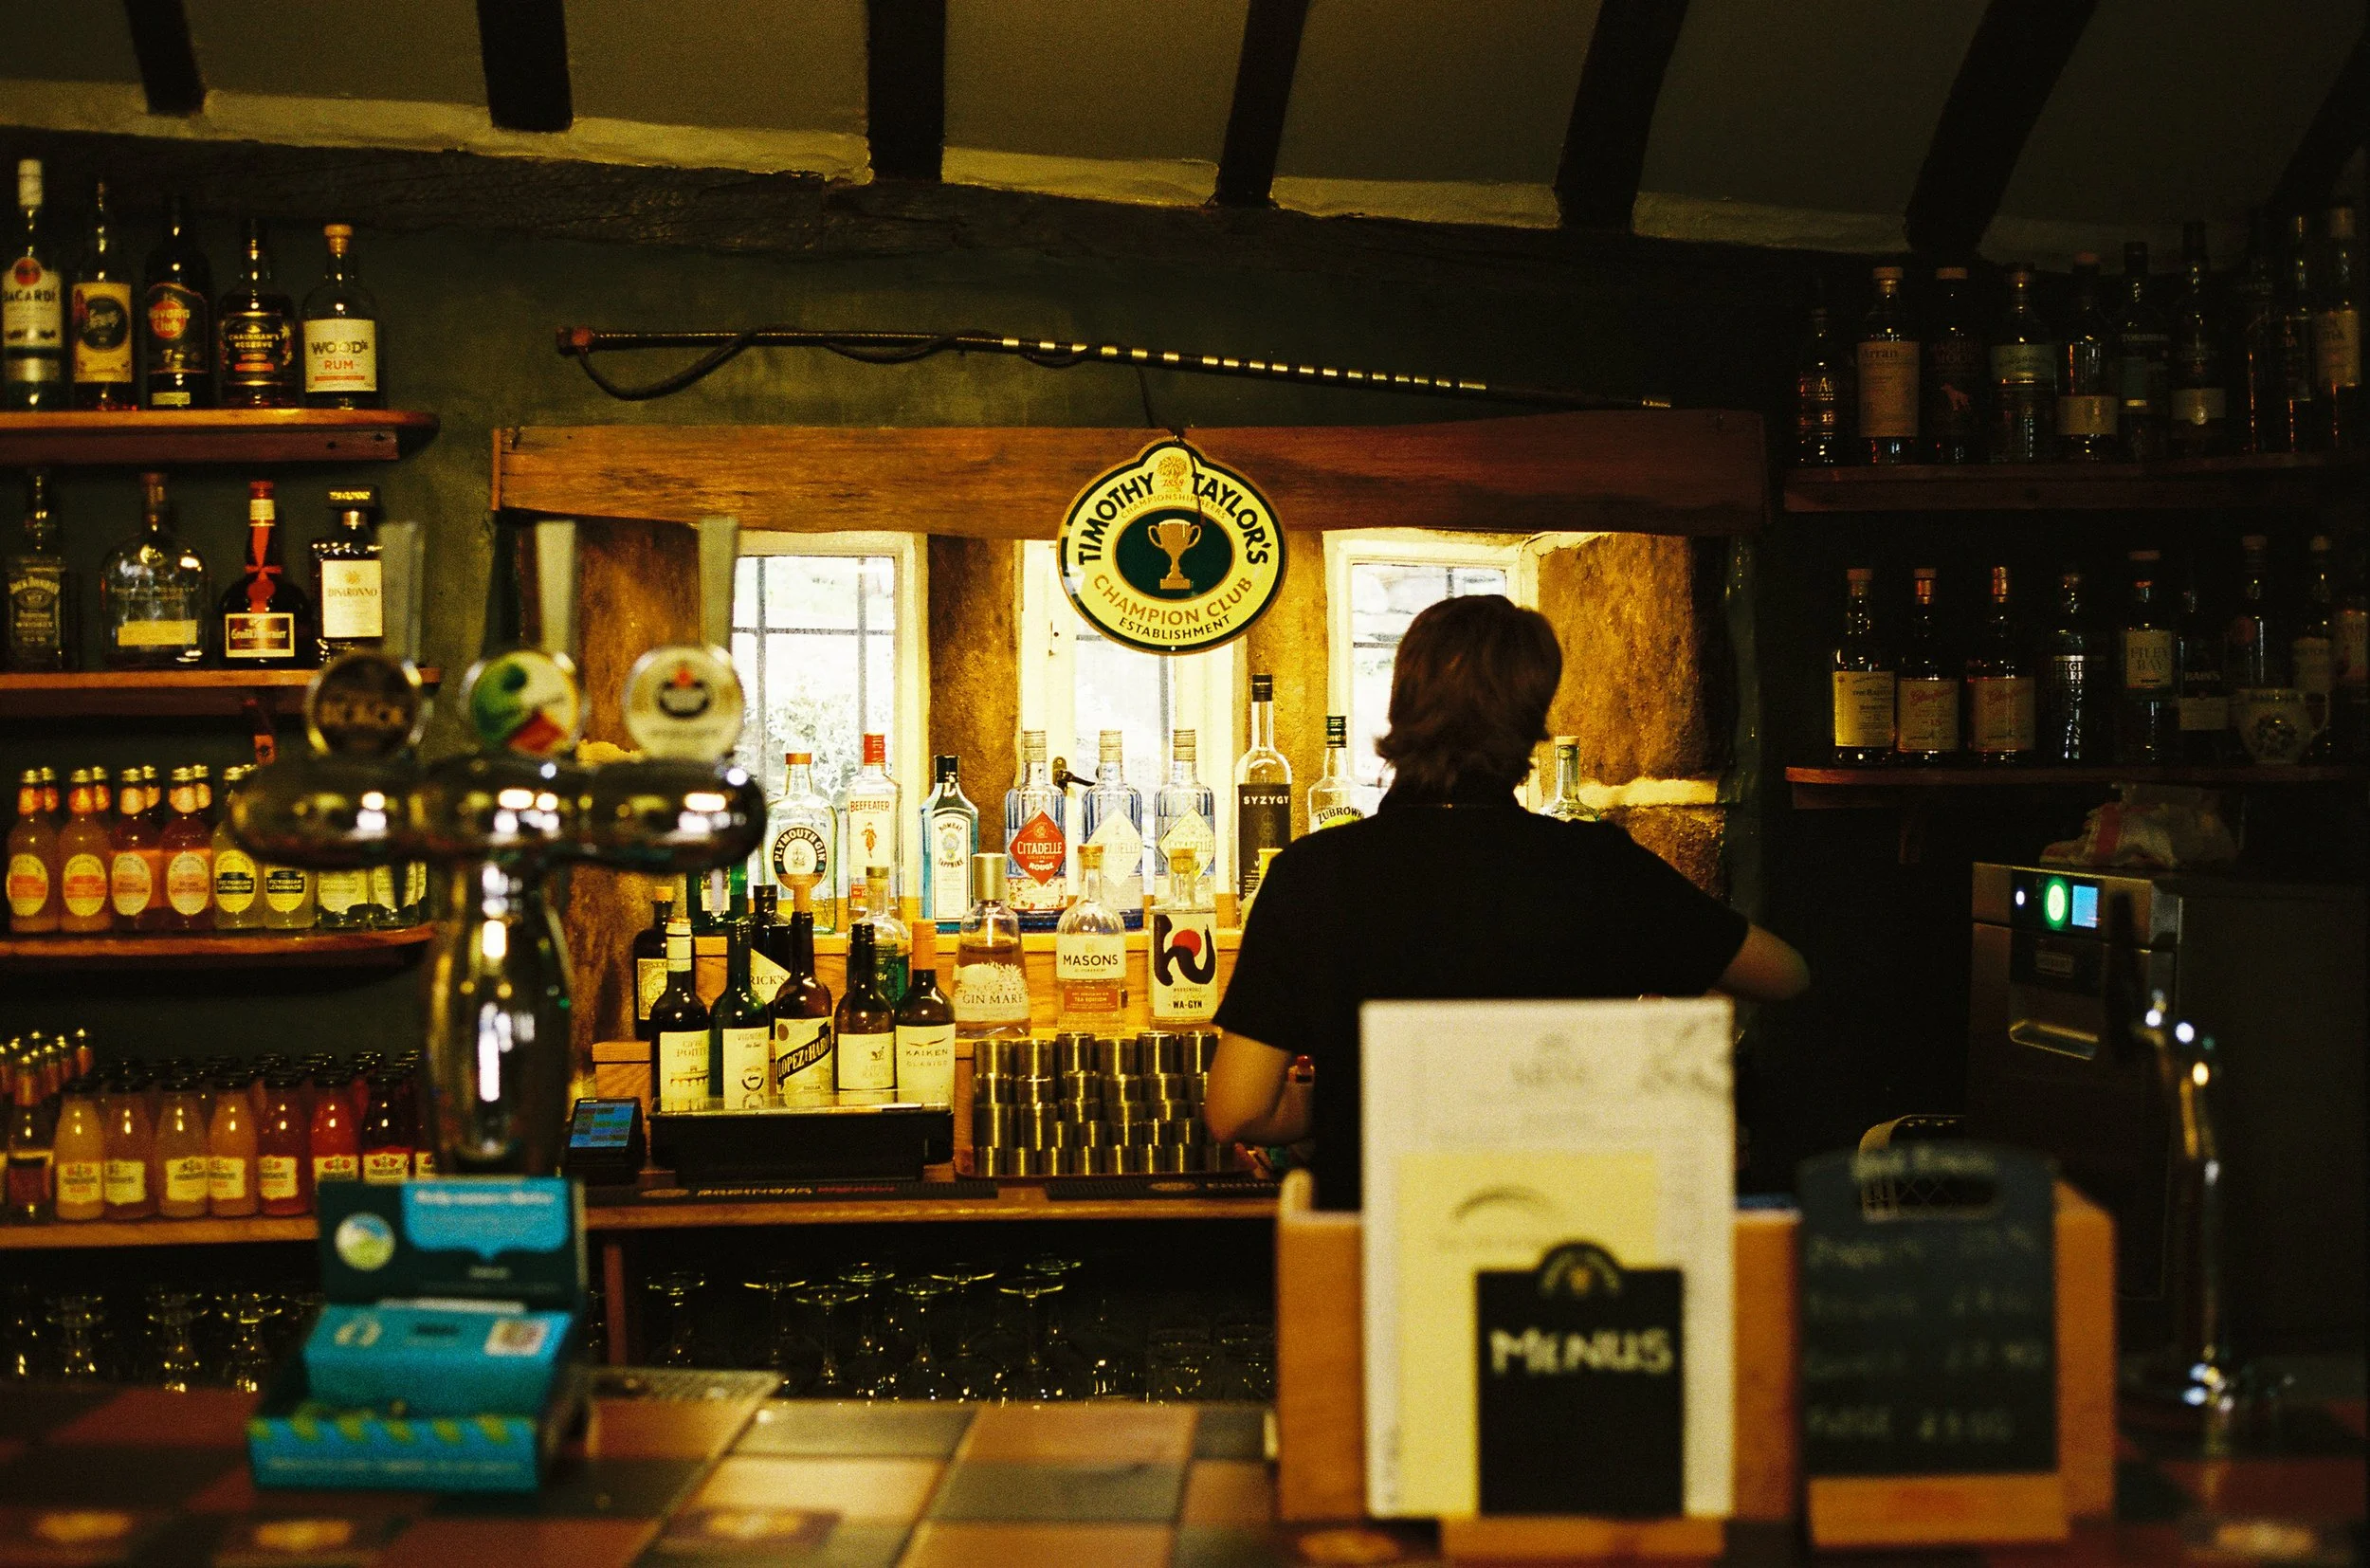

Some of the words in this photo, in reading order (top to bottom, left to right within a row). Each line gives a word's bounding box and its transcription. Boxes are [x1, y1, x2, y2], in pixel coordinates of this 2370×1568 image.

[324, 359, 355, 371] RUM
[1078, 471, 1155, 566] TIMOTHY
[1191, 472, 1272, 566] TAYLOR'S
[1094, 574, 1200, 627] CHAMPION
[1206, 577, 1253, 618] CLUB
[1119, 614, 1231, 641] ESTABLISHMENT
[849, 800, 890, 812] BEEFEATER
[1243, 795, 1289, 805] SYZYGY
[938, 822, 964, 833] BOMBAY
[774, 828, 818, 862] PLYMOUTH
[814, 840, 827, 862] GIN
[1017, 841, 1063, 855] CITADELLE
[938, 856, 965, 868] SAPPHIRE
[1063, 954, 1119, 966] MASONS
[962, 994, 986, 1005] GIN
[989, 994, 1024, 1005] MARE
[1173, 1000, 1203, 1009] WA-GYN
[905, 1048, 949, 1058] KAIKEN
[777, 1048, 806, 1078] LOPEZ
